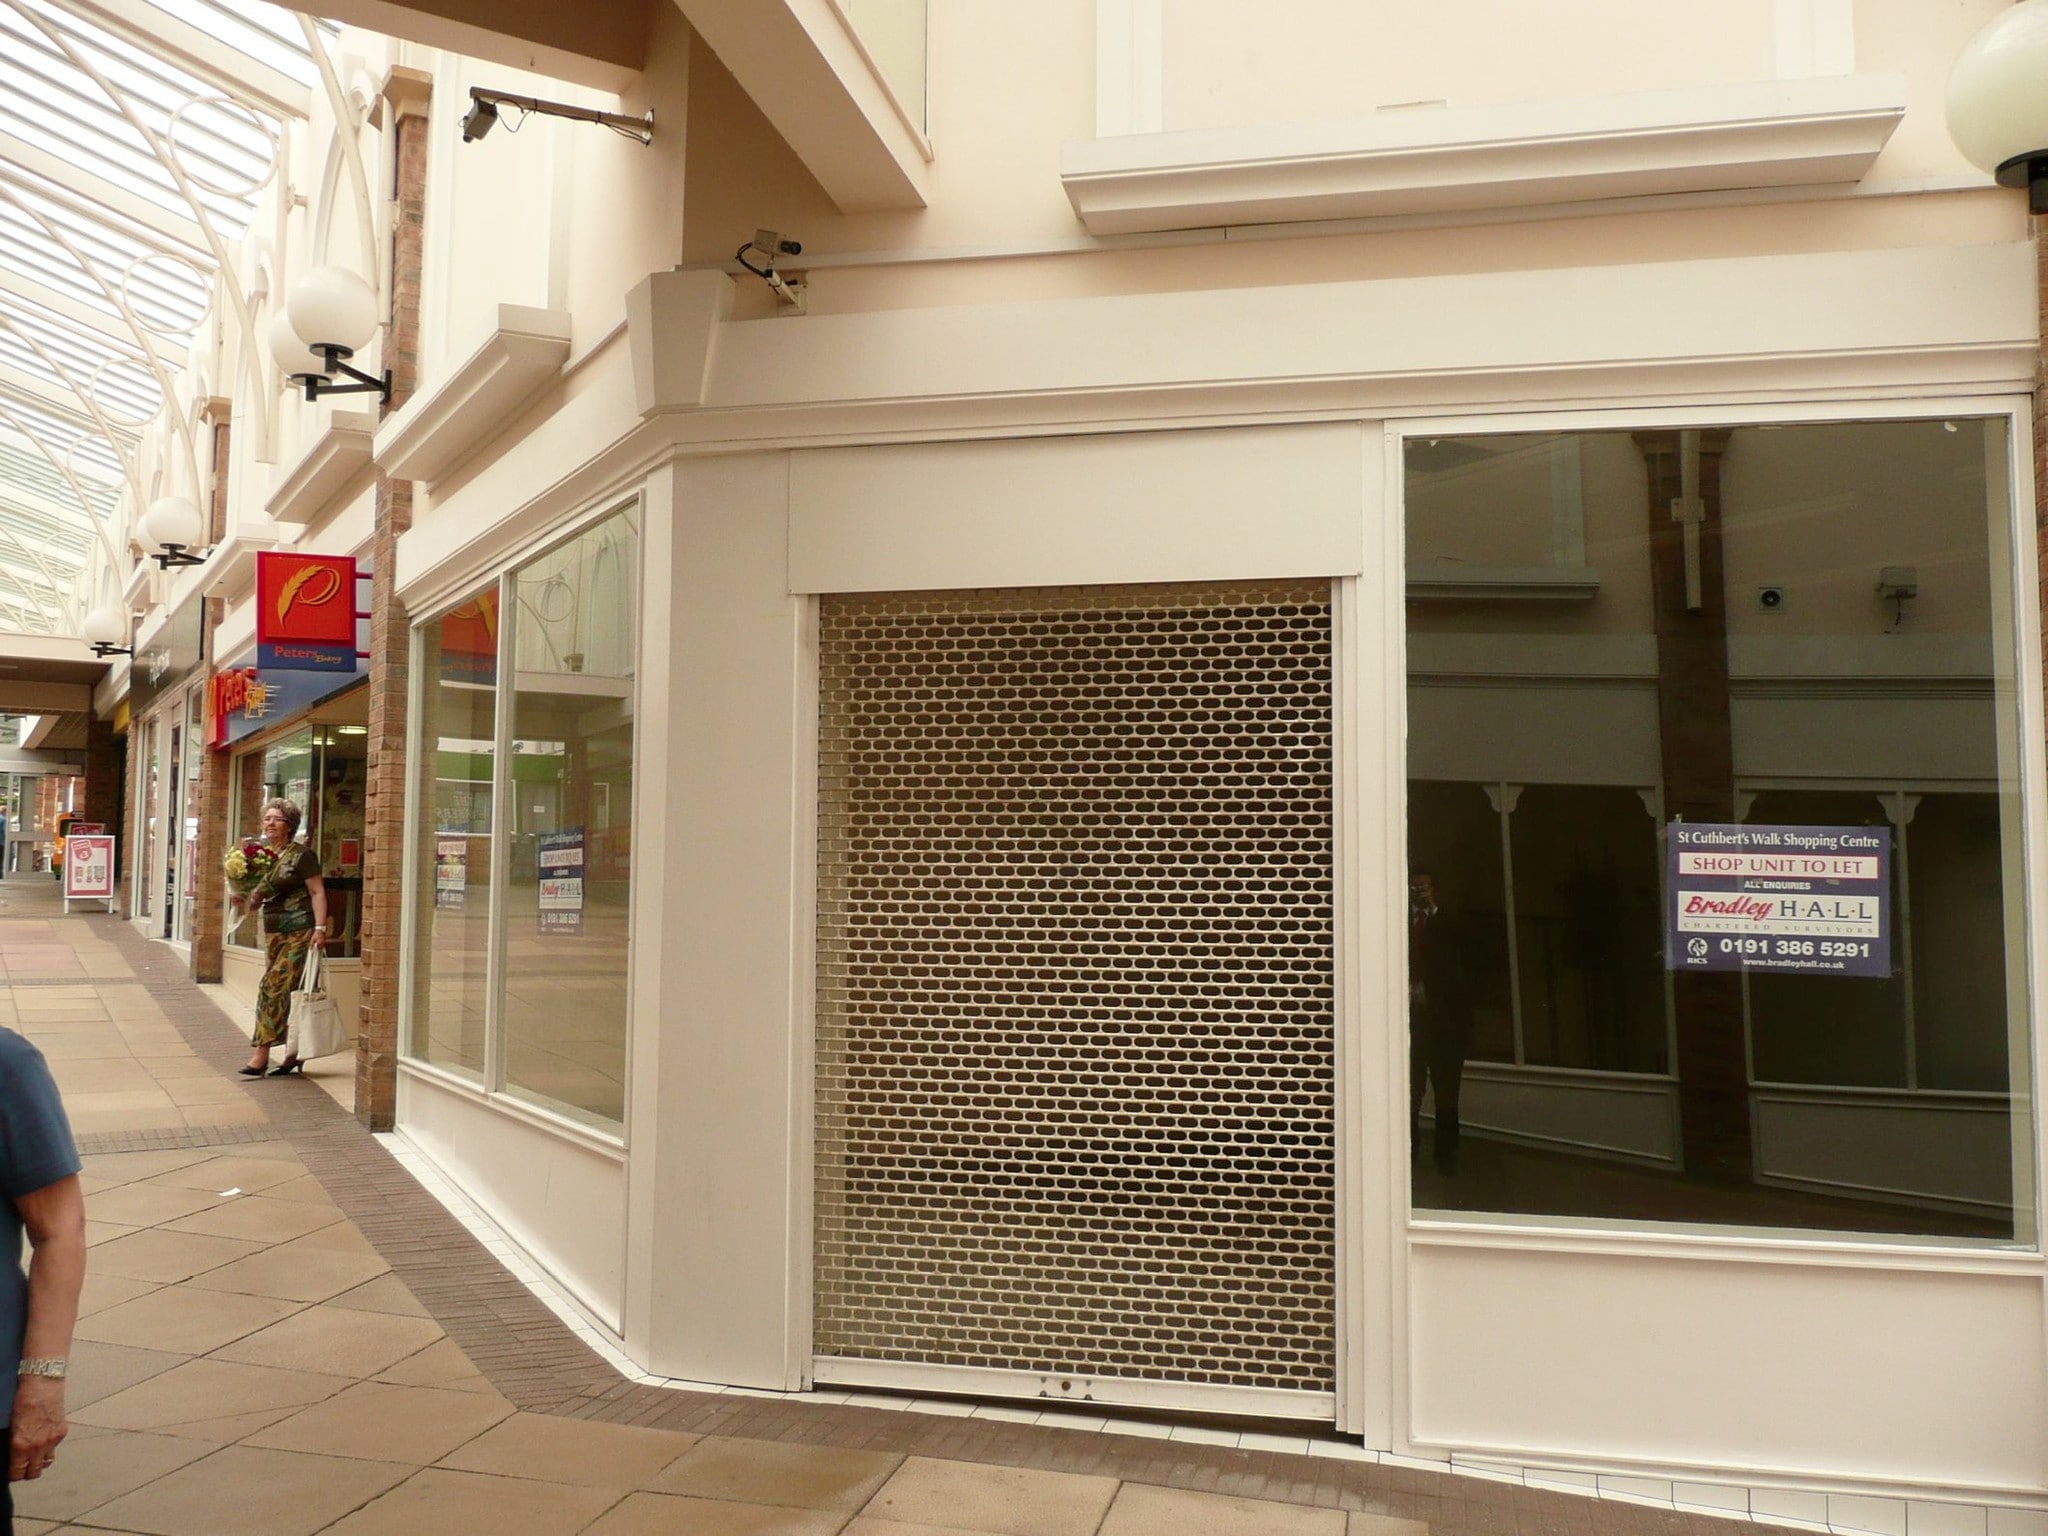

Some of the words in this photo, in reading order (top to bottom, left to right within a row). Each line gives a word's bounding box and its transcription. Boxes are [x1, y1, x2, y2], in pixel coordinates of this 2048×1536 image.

[274, 645, 317, 659] Peters
[1678, 831, 1689, 844] St
[1692, 832, 1750, 846] Cuthbert's
[1752, 833, 1781, 846] Walk
[1784, 834, 1838, 850] Shopping
[1840, 835, 1880, 848] Centre
[1693, 857, 1743, 871] SHOP
[1751, 859, 1796, 872] UNIT
[1801, 860, 1826, 873] TO
[1833, 861, 1863, 874] LET
[1744, 881, 1761, 889] ALL
[1763, 882, 1811, 890] ENQUIRIES
[1685, 896, 1774, 921] Bradley
[1684, 922, 1771, 931] CHARTERED
[1784, 925, 1873, 934] SURVEYORS
[1720, 938, 1768, 954] 0191
[1776, 940, 1814, 957] 386
[1821, 941, 1870, 957] 5291
[1687, 957, 1708, 965] RICS
[1743, 958, 1845, 969] www.bradleyhall.co.uk
